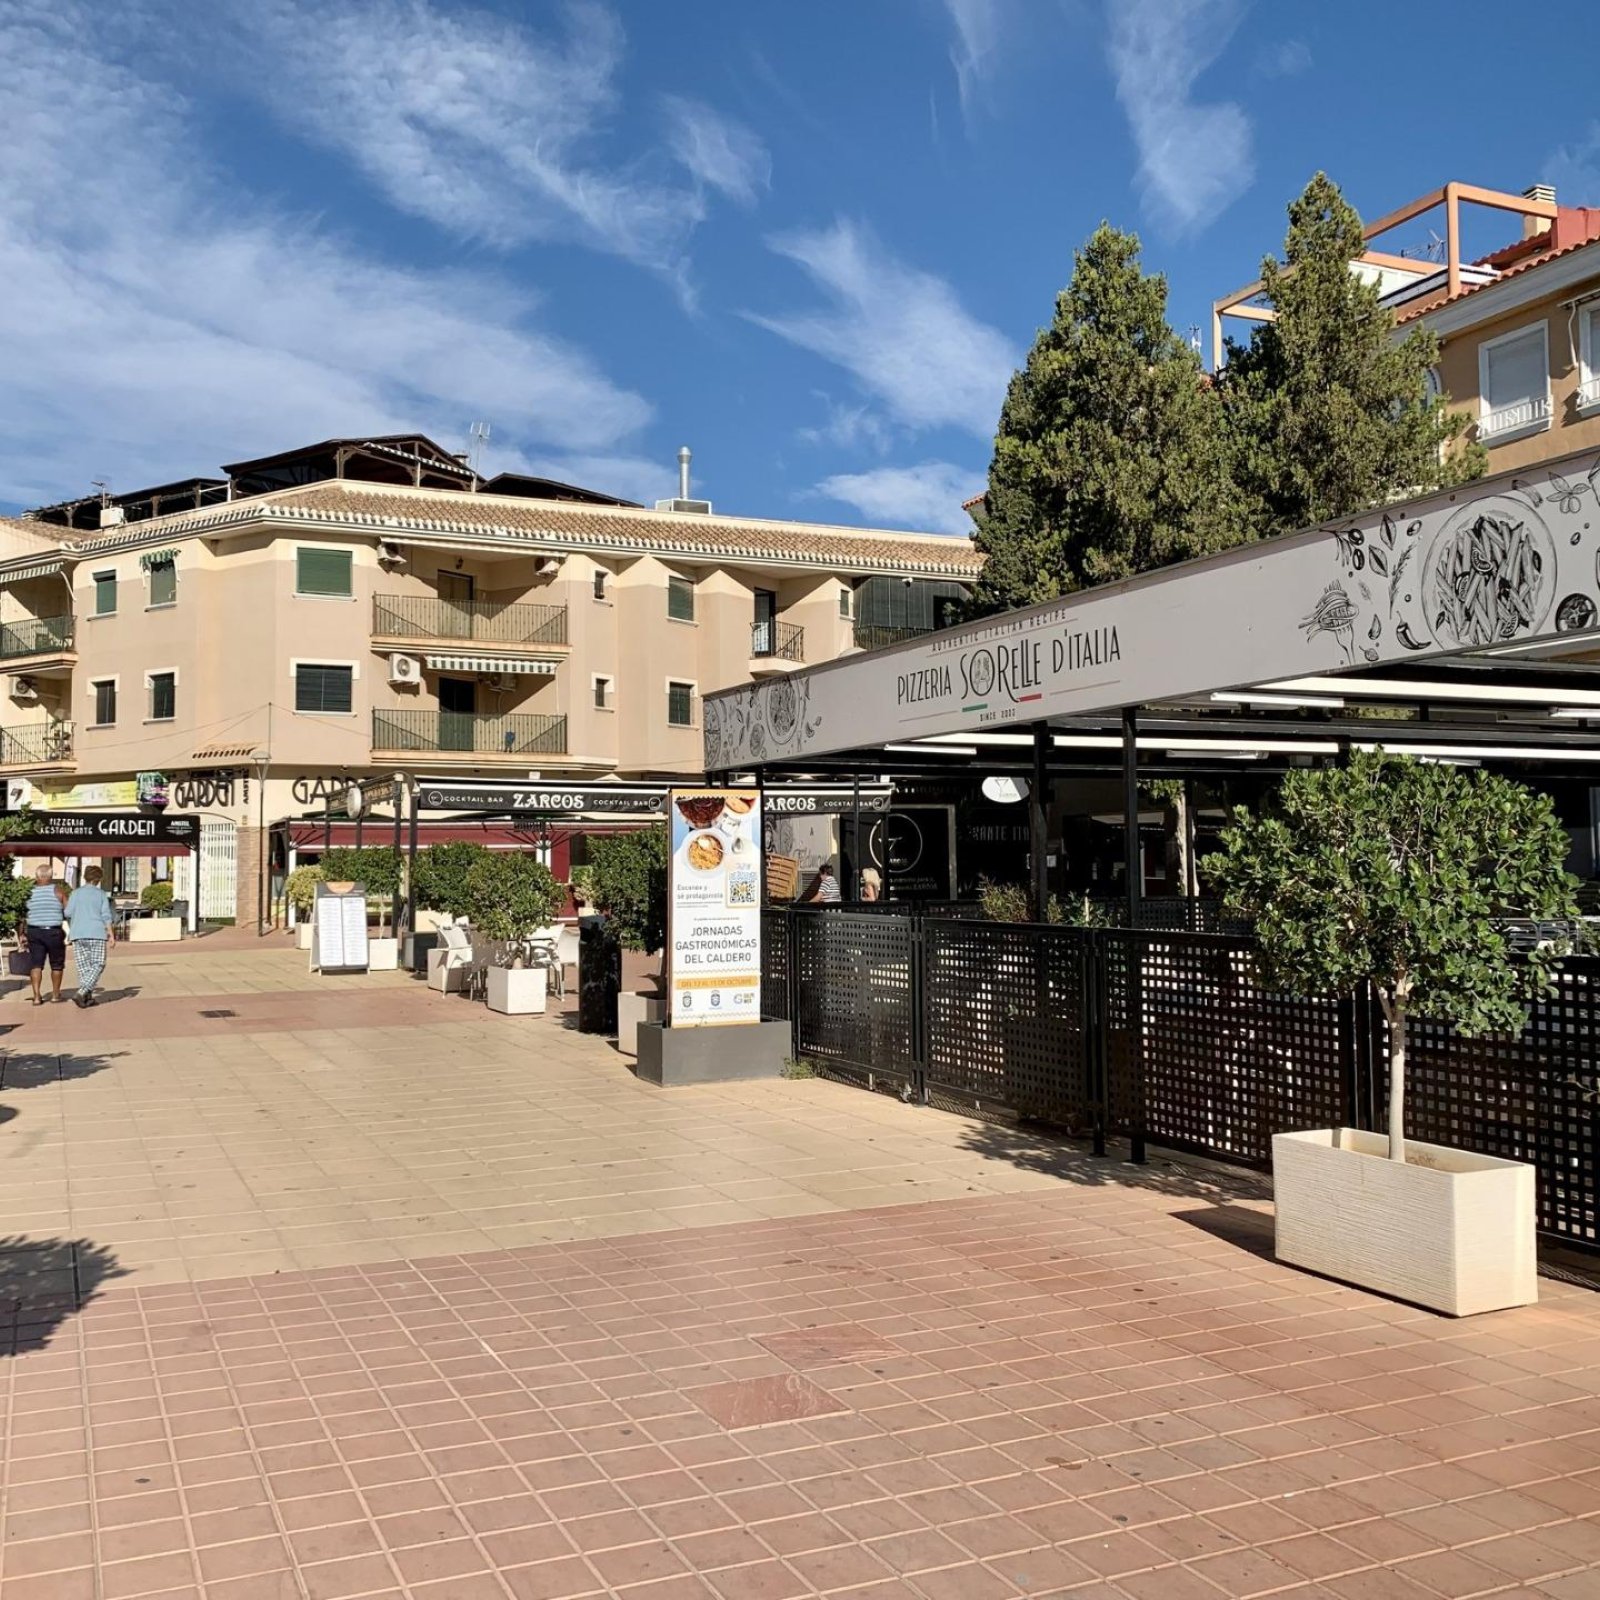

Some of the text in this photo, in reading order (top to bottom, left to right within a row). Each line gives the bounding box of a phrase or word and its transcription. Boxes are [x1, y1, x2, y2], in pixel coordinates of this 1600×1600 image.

[932, 609, 1066, 651] AUTHENTIC ITALIAN RECIPE
[898, 665, 951, 705] PIZZERIA
[1053, 625, 1120, 674] D'ITALIA
[980, 711, 996, 722] SINCE
[444, 795, 483, 803] COCKTAIL
[513, 793, 584, 809] ZARCOS
[593, 799, 630, 807] COCKTAIL
[764, 797, 816, 811] ARCOS
[40, 826, 93, 835] RESTAURANTE
[98, 819, 155, 836] GARDEN
[50, 818, 84, 826] PIZZERIA
[691, 925, 743, 937] JORNADAS
[675, 937, 757, 951] GASTRONÓMICAS
[684, 952, 751, 964] DEL CALDERO
